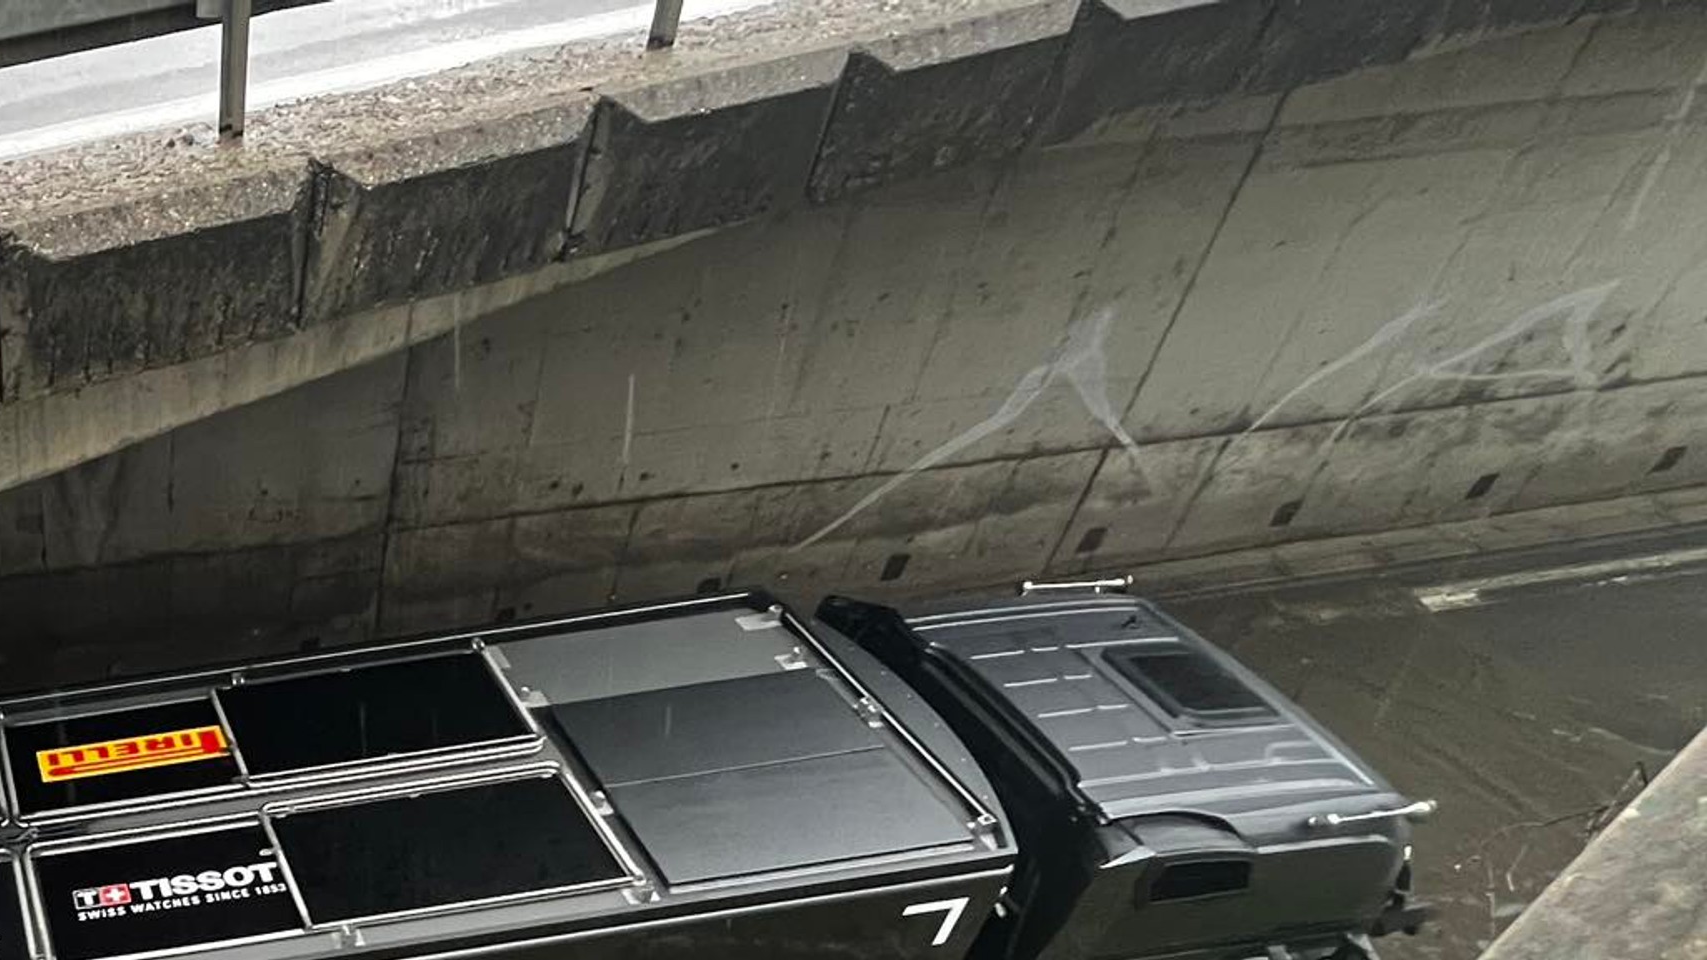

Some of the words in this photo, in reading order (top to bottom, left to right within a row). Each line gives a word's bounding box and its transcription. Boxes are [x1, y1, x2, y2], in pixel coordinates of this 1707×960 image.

[47, 728, 232, 777] PIRELLI
[129, 861, 278, 900] TISSOT
[78, 907, 127, 922] SWISS
[130, 894, 201, 914] WATCHES
[205, 889, 250, 903] SINCE
[254, 883, 287, 896] 1853
